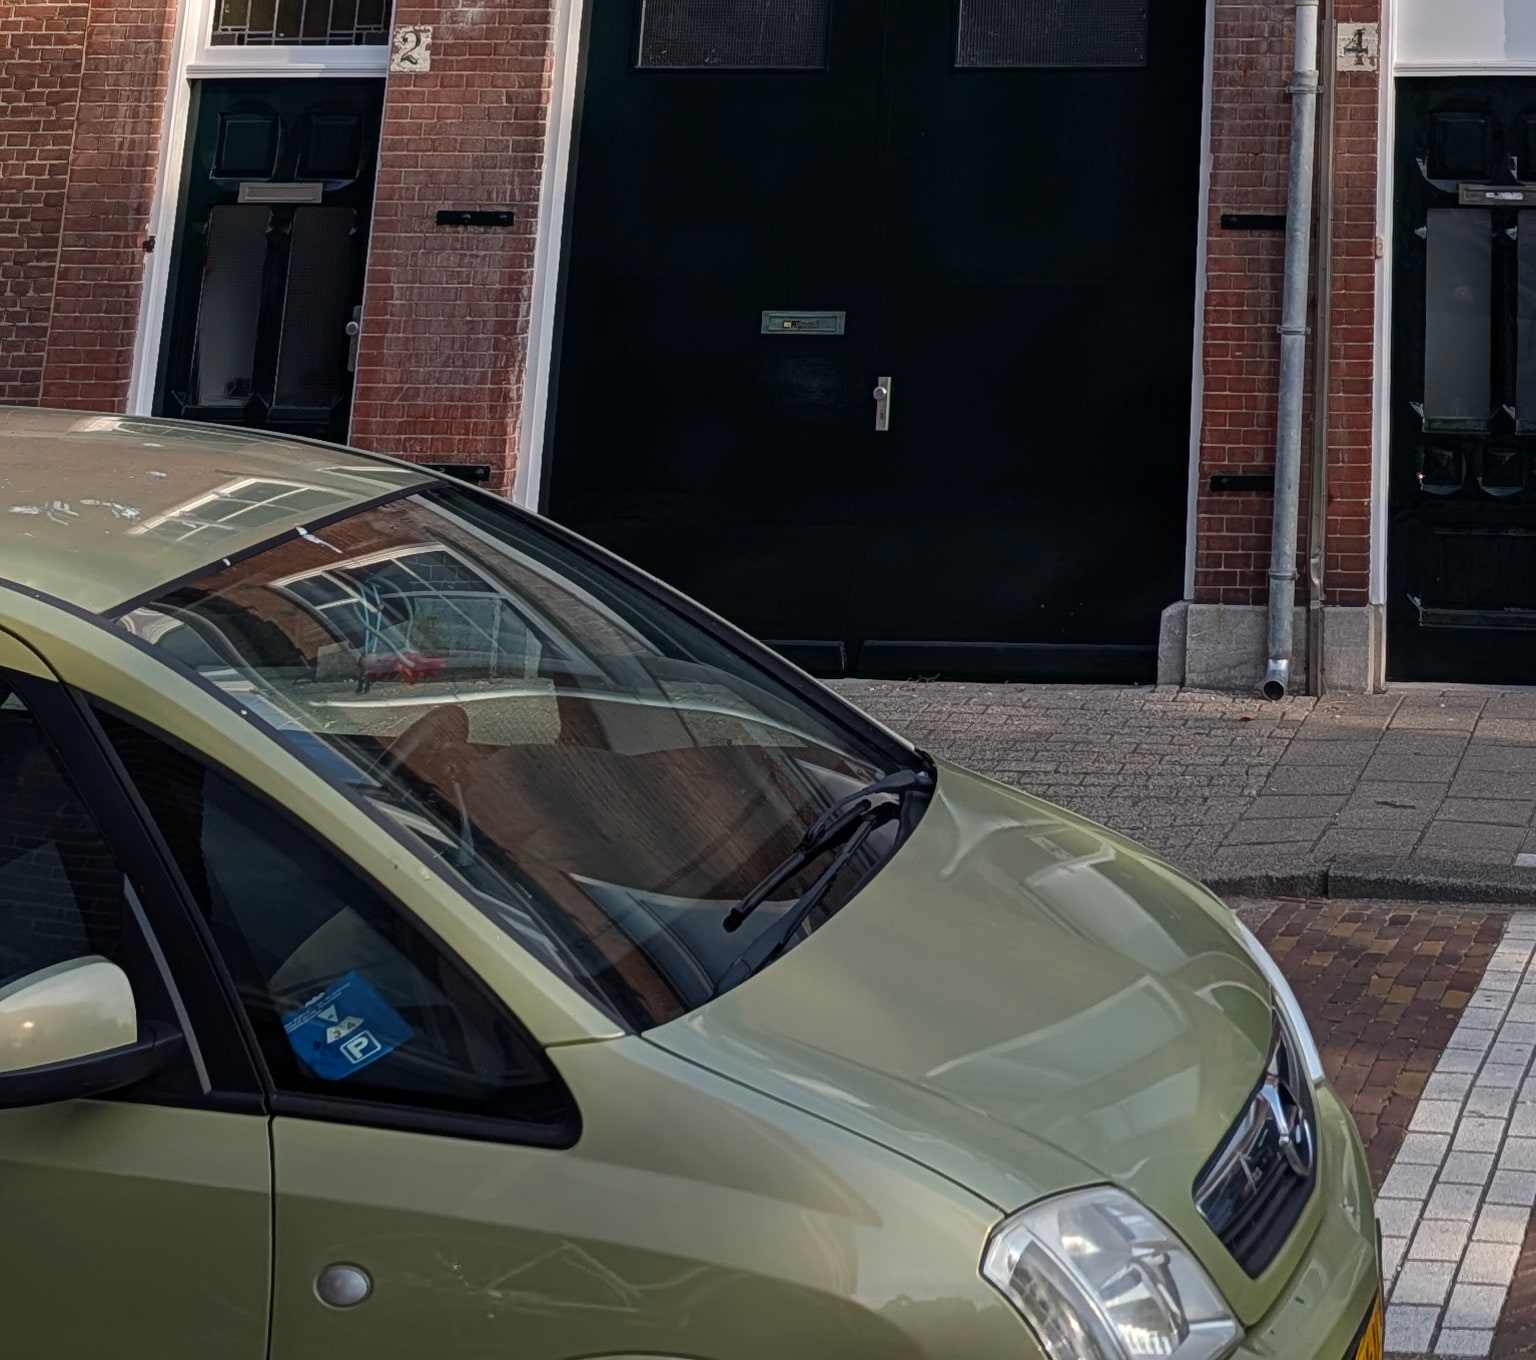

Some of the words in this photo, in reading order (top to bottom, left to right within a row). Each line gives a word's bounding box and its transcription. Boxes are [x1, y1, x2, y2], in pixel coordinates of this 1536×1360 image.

[400, 30, 421, 65] 2
[1343, 26, 1369, 66] 4
[346, 1036, 369, 1060] P
